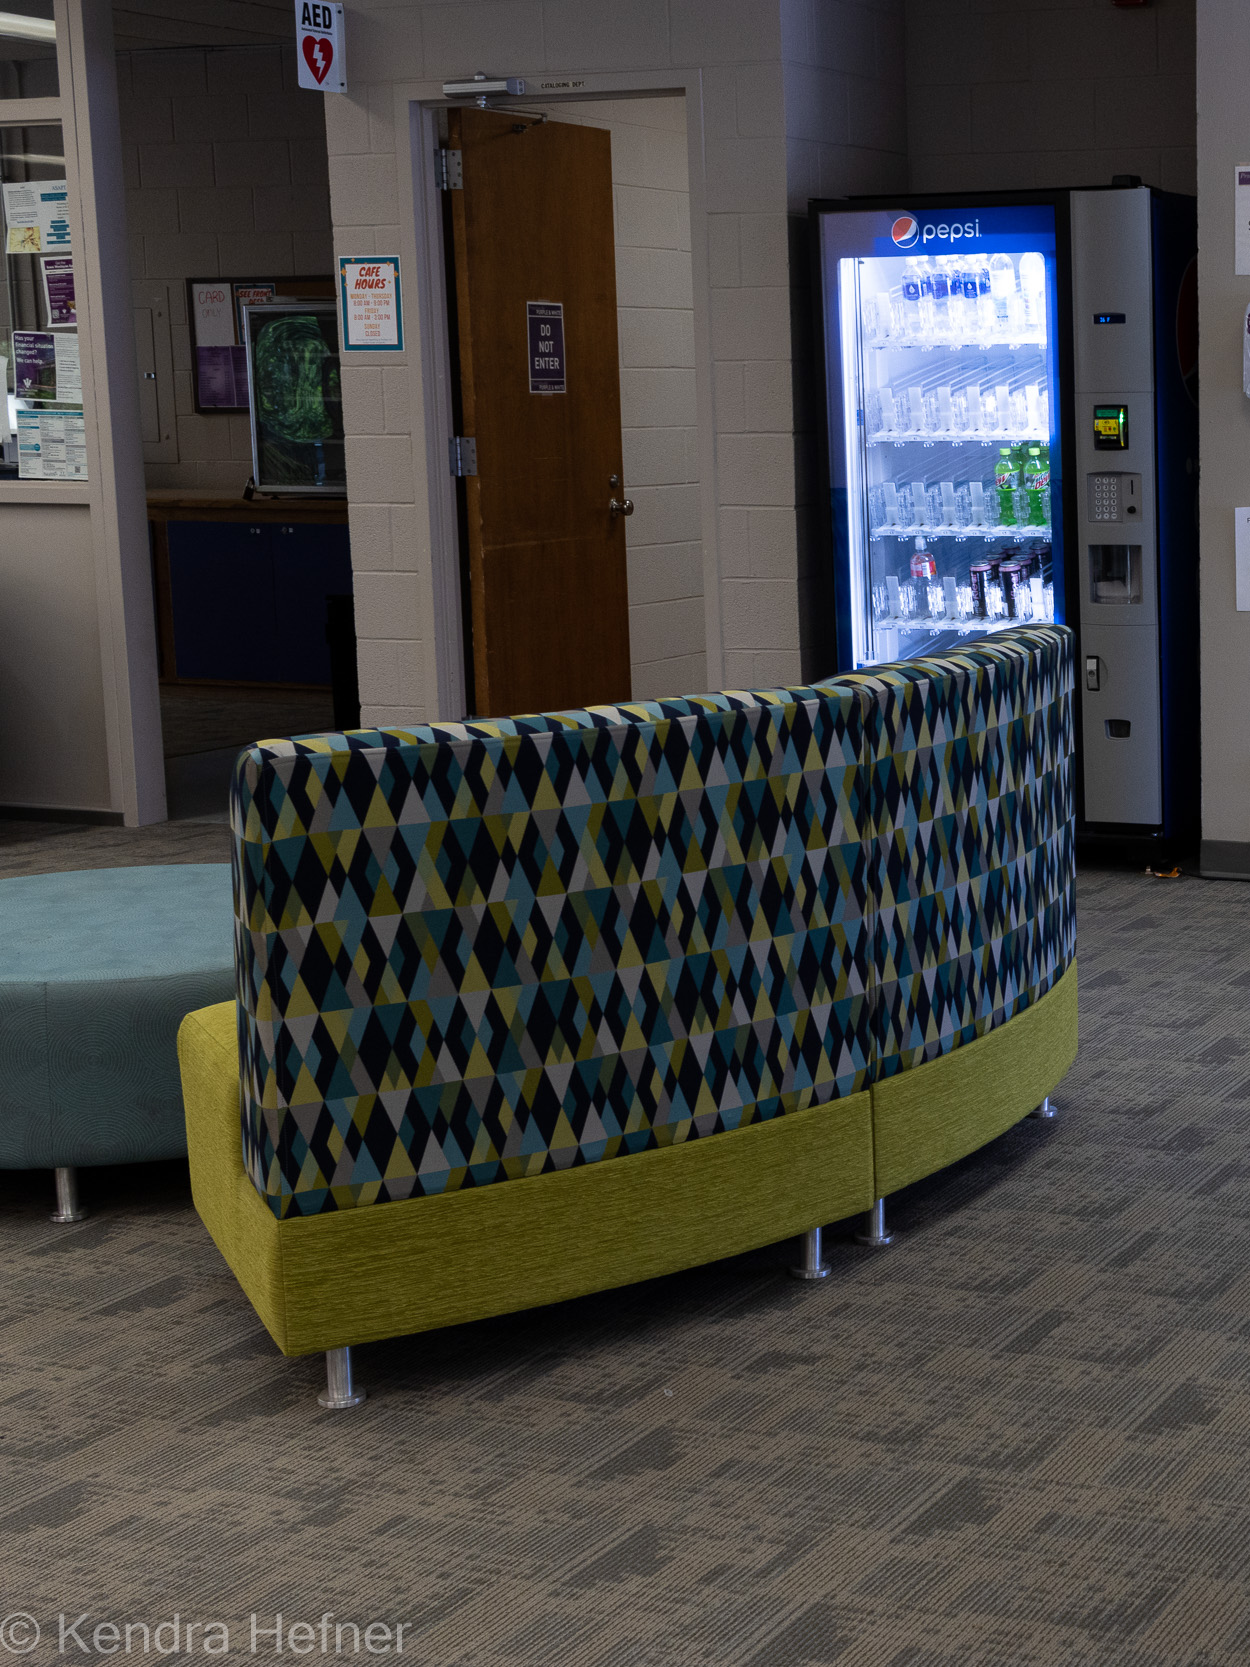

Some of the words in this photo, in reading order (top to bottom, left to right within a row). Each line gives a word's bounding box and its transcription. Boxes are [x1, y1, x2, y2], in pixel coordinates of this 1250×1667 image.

[302, 2, 331, 29] AED
[923, 219, 979, 244] pepsi
[359, 266, 381, 277] CAFE
[354, 279, 386, 289] HOURS
[198, 290, 225, 304] CARD
[540, 324, 551, 336] DO
[539, 341, 554, 353] NOT
[534, 358, 560, 369] ENTER
